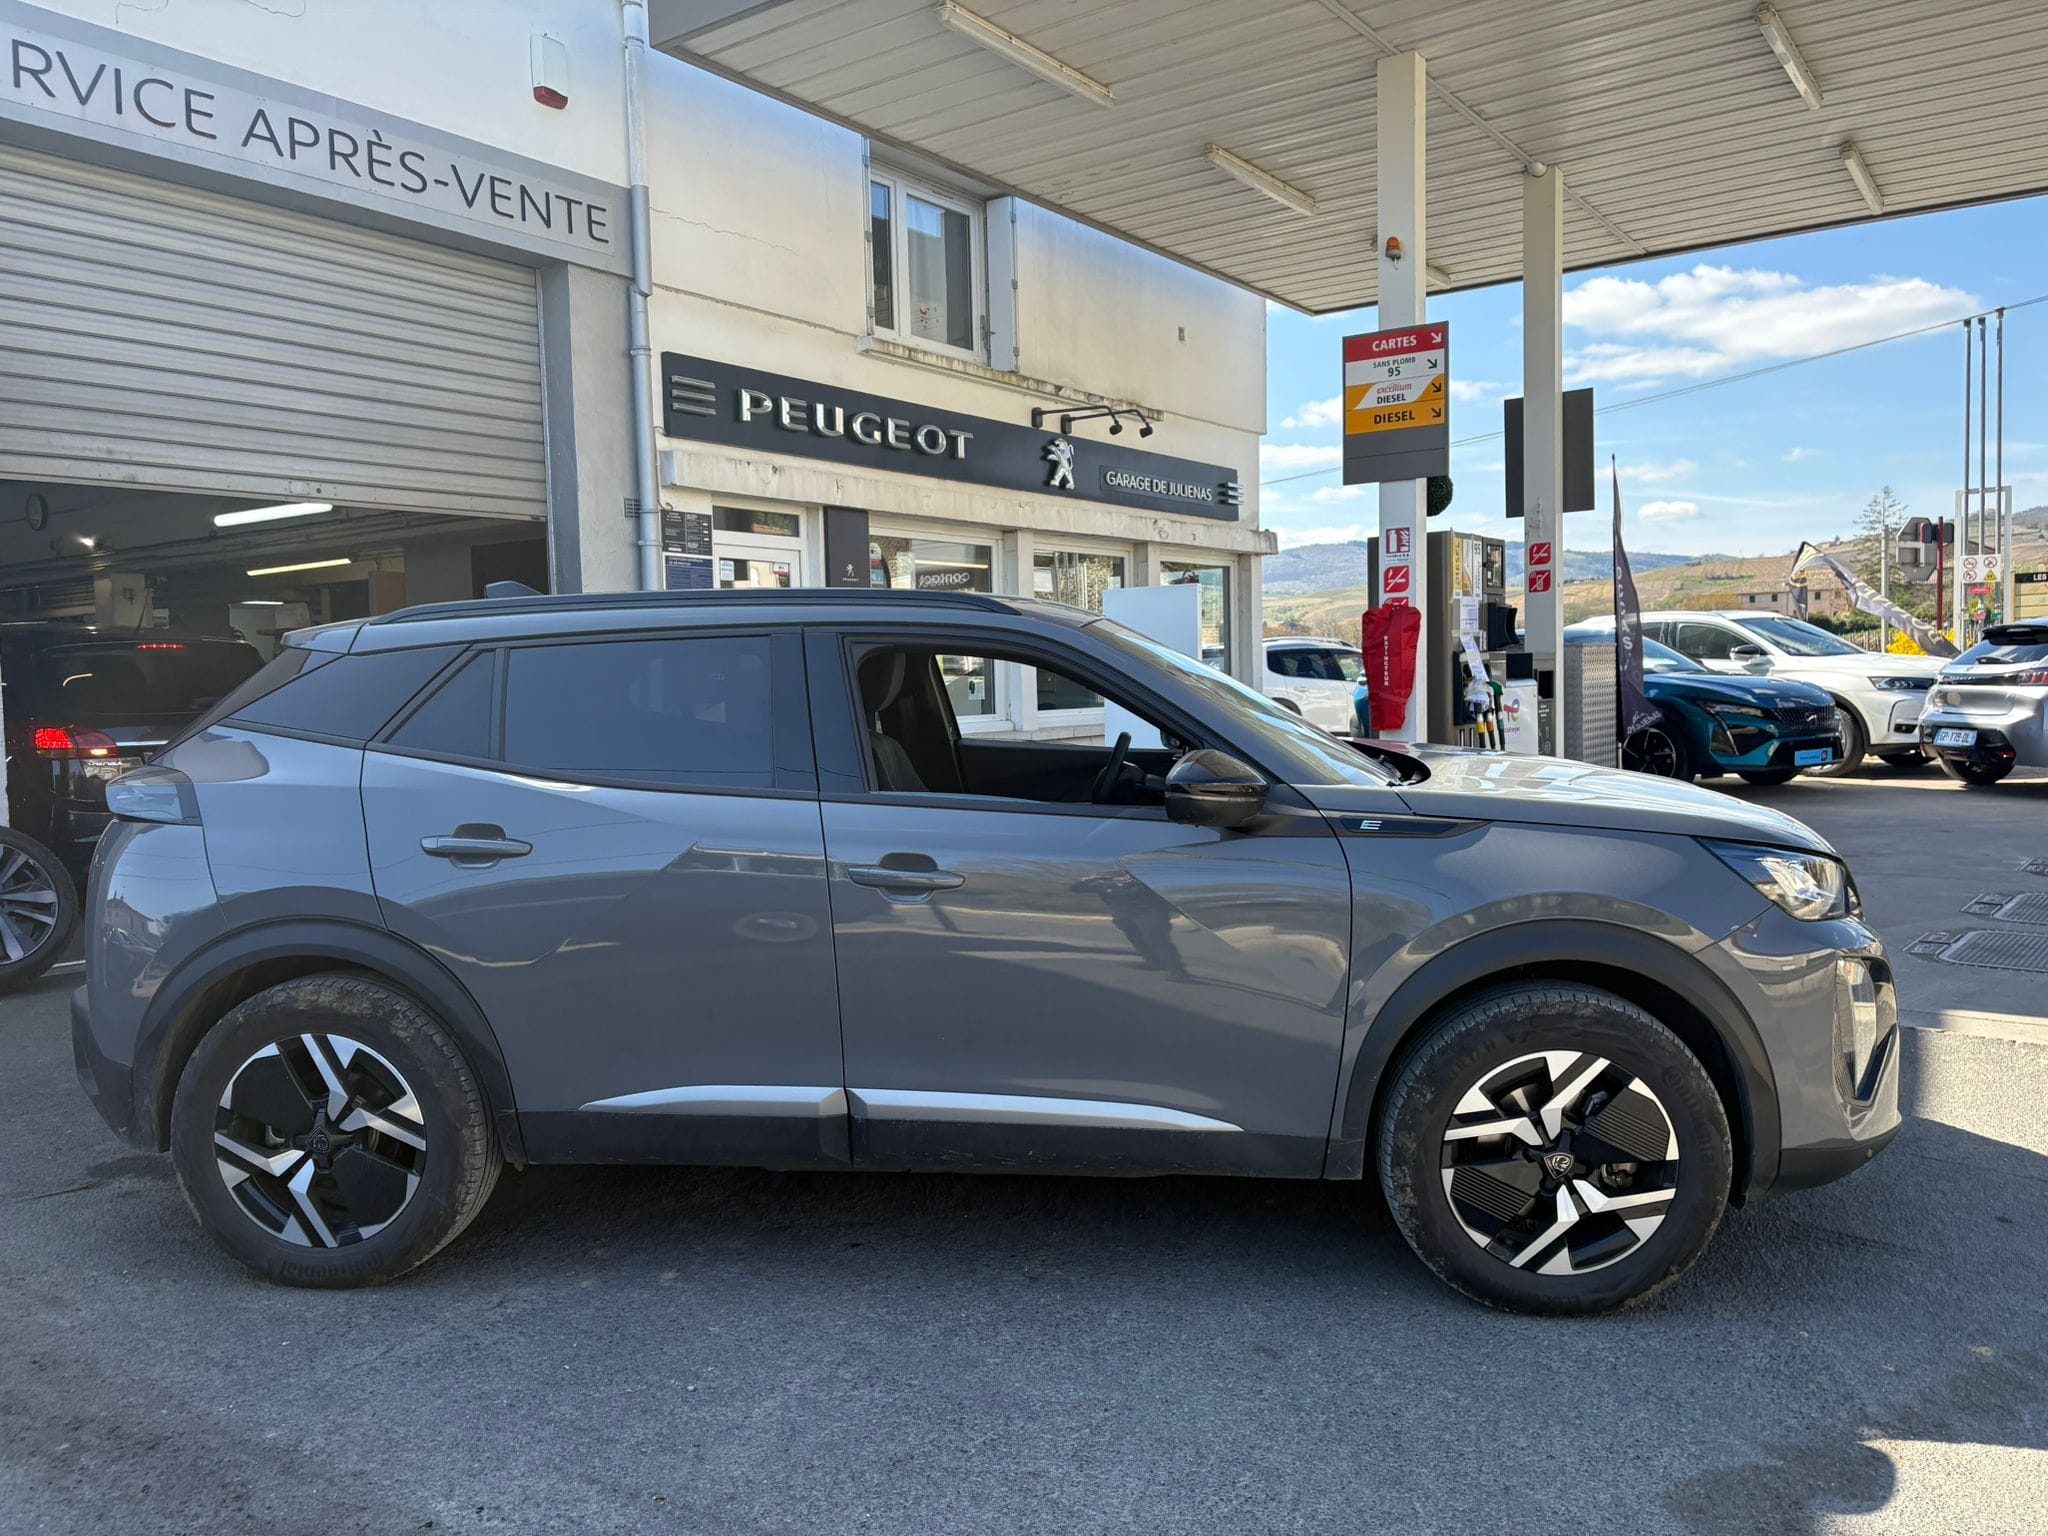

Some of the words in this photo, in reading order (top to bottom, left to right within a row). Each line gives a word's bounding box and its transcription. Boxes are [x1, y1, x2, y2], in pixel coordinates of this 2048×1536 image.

[11, 38, 217, 140] RVICE
[241, 107, 611, 245] APRÈS-VENTE
[1372, 335, 1417, 352] CARTES
[1373, 360, 1391, 369] SANS
[1393, 357, 1416, 366] PLOMB
[1388, 366, 1401, 377] 95
[1376, 394, 1406, 404] DIESEL
[737, 387, 975, 460] PEUGEOT
[1374, 410, 1415, 424] DIESEL
[1106, 471, 1151, 491] GARAGE
[1153, 479, 1167, 493] DE
[1168, 482, 1212, 501] JULIENAS
